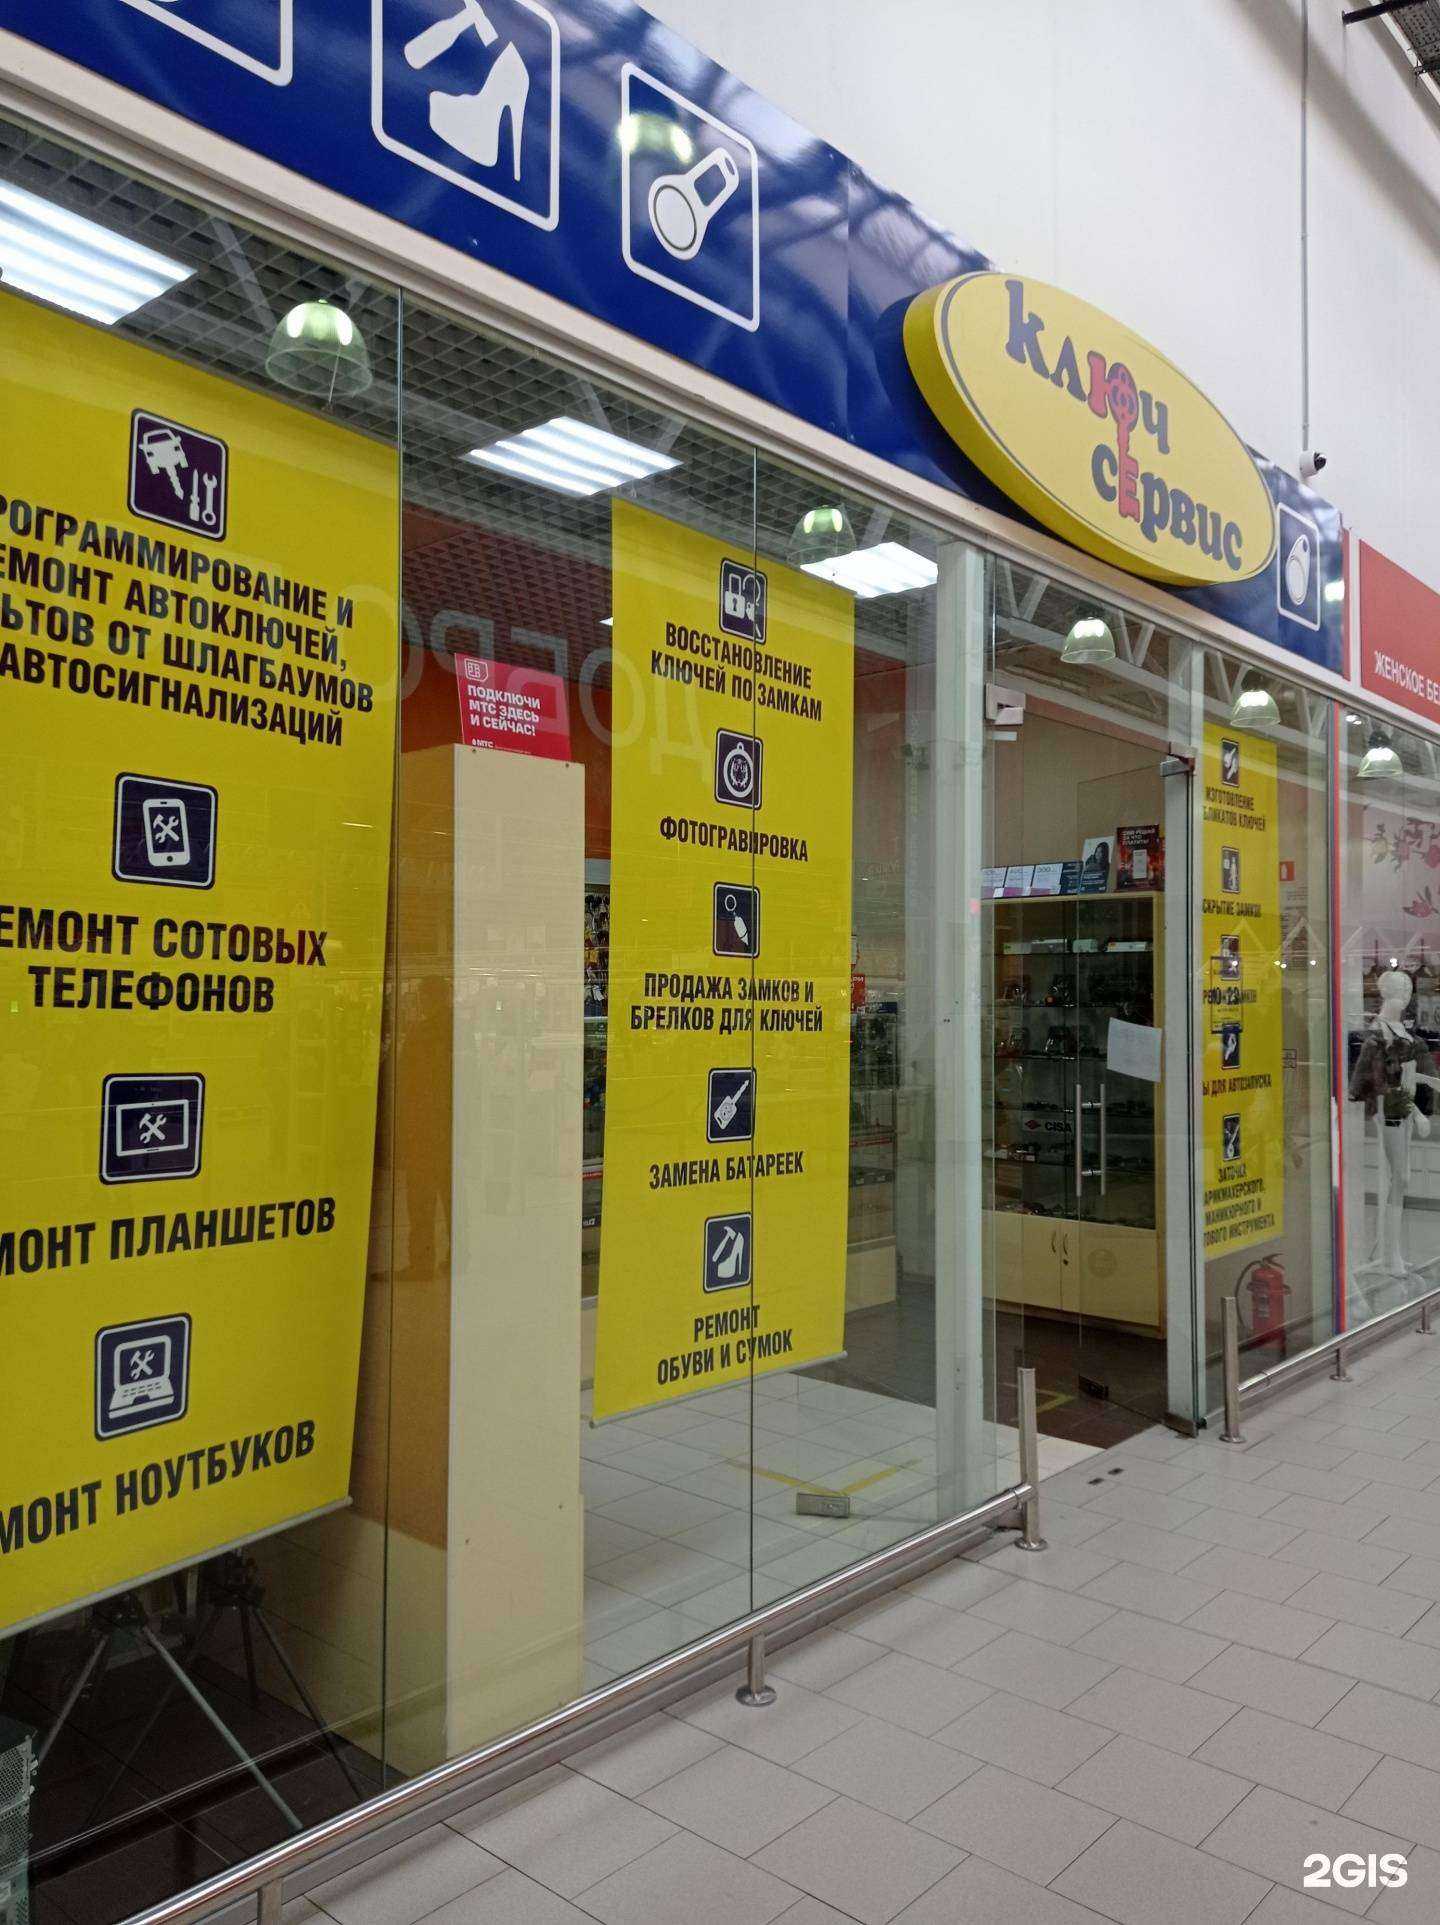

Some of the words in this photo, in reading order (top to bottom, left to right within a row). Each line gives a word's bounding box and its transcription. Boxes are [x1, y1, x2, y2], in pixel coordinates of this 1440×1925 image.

[124, 578, 347, 672] АВТОКЛЮЧЕЙ,
[337, 596, 354, 630] И
[108, 619, 151, 662] ОТ
[163, 632, 374, 714] ШЛАГБАУМОВ
[665, 621, 812, 690] ВОССТАНОВЛЕНИЕ
[1373, 650, 1425, 698] ЖЕНСКОЕ
[0, 642, 343, 747] АВТОСИГНАЛИЗАЦИЙ
[467, 684, 541, 710] ПОДКЛЮЧИ
[651, 649, 726, 694] КЛЮЧЕЙ
[731, 672, 753, 702] ПО
[756, 682, 823, 722] ЗАМКАМ
[468, 699, 497, 714] МТС
[499, 705, 540, 723] ЗДЕСЬ
[470, 713, 480, 727] И
[483, 716, 536, 736] СЕЙЧАС!
[659, 815, 809, 862] ФОТОГРАВИРОВКА
[152, 917, 328, 967] СОТОВЫХ
[27, 965, 275, 1015] ТЕЛЕФОНОВ
[645, 972, 733, 1003] ПРОДАЖА
[738, 977, 800, 1003] ЗАМКОВ
[804, 980, 814, 1003] И
[630, 1005, 713, 1031] БРЕЛКОВ
[719, 1007, 753, 1035] ДЛЯ
[760, 1004, 823, 1032] КЛЮЧЕЙ
[649, 1155, 721, 1190] ЗАМЕНА
[725, 1151, 804, 1182] БАТАРЕЕК
[110, 1196, 337, 1260] ПЛАНШЕТОВ
[693, 1304, 760, 1343] РЕМОНТ
[657, 1348, 715, 1386] ОБУВИ
[720, 1342, 732, 1369] И
[736, 1328, 794, 1365] СУМОК
[115, 1418, 316, 1515] НОУТБУКОВ
